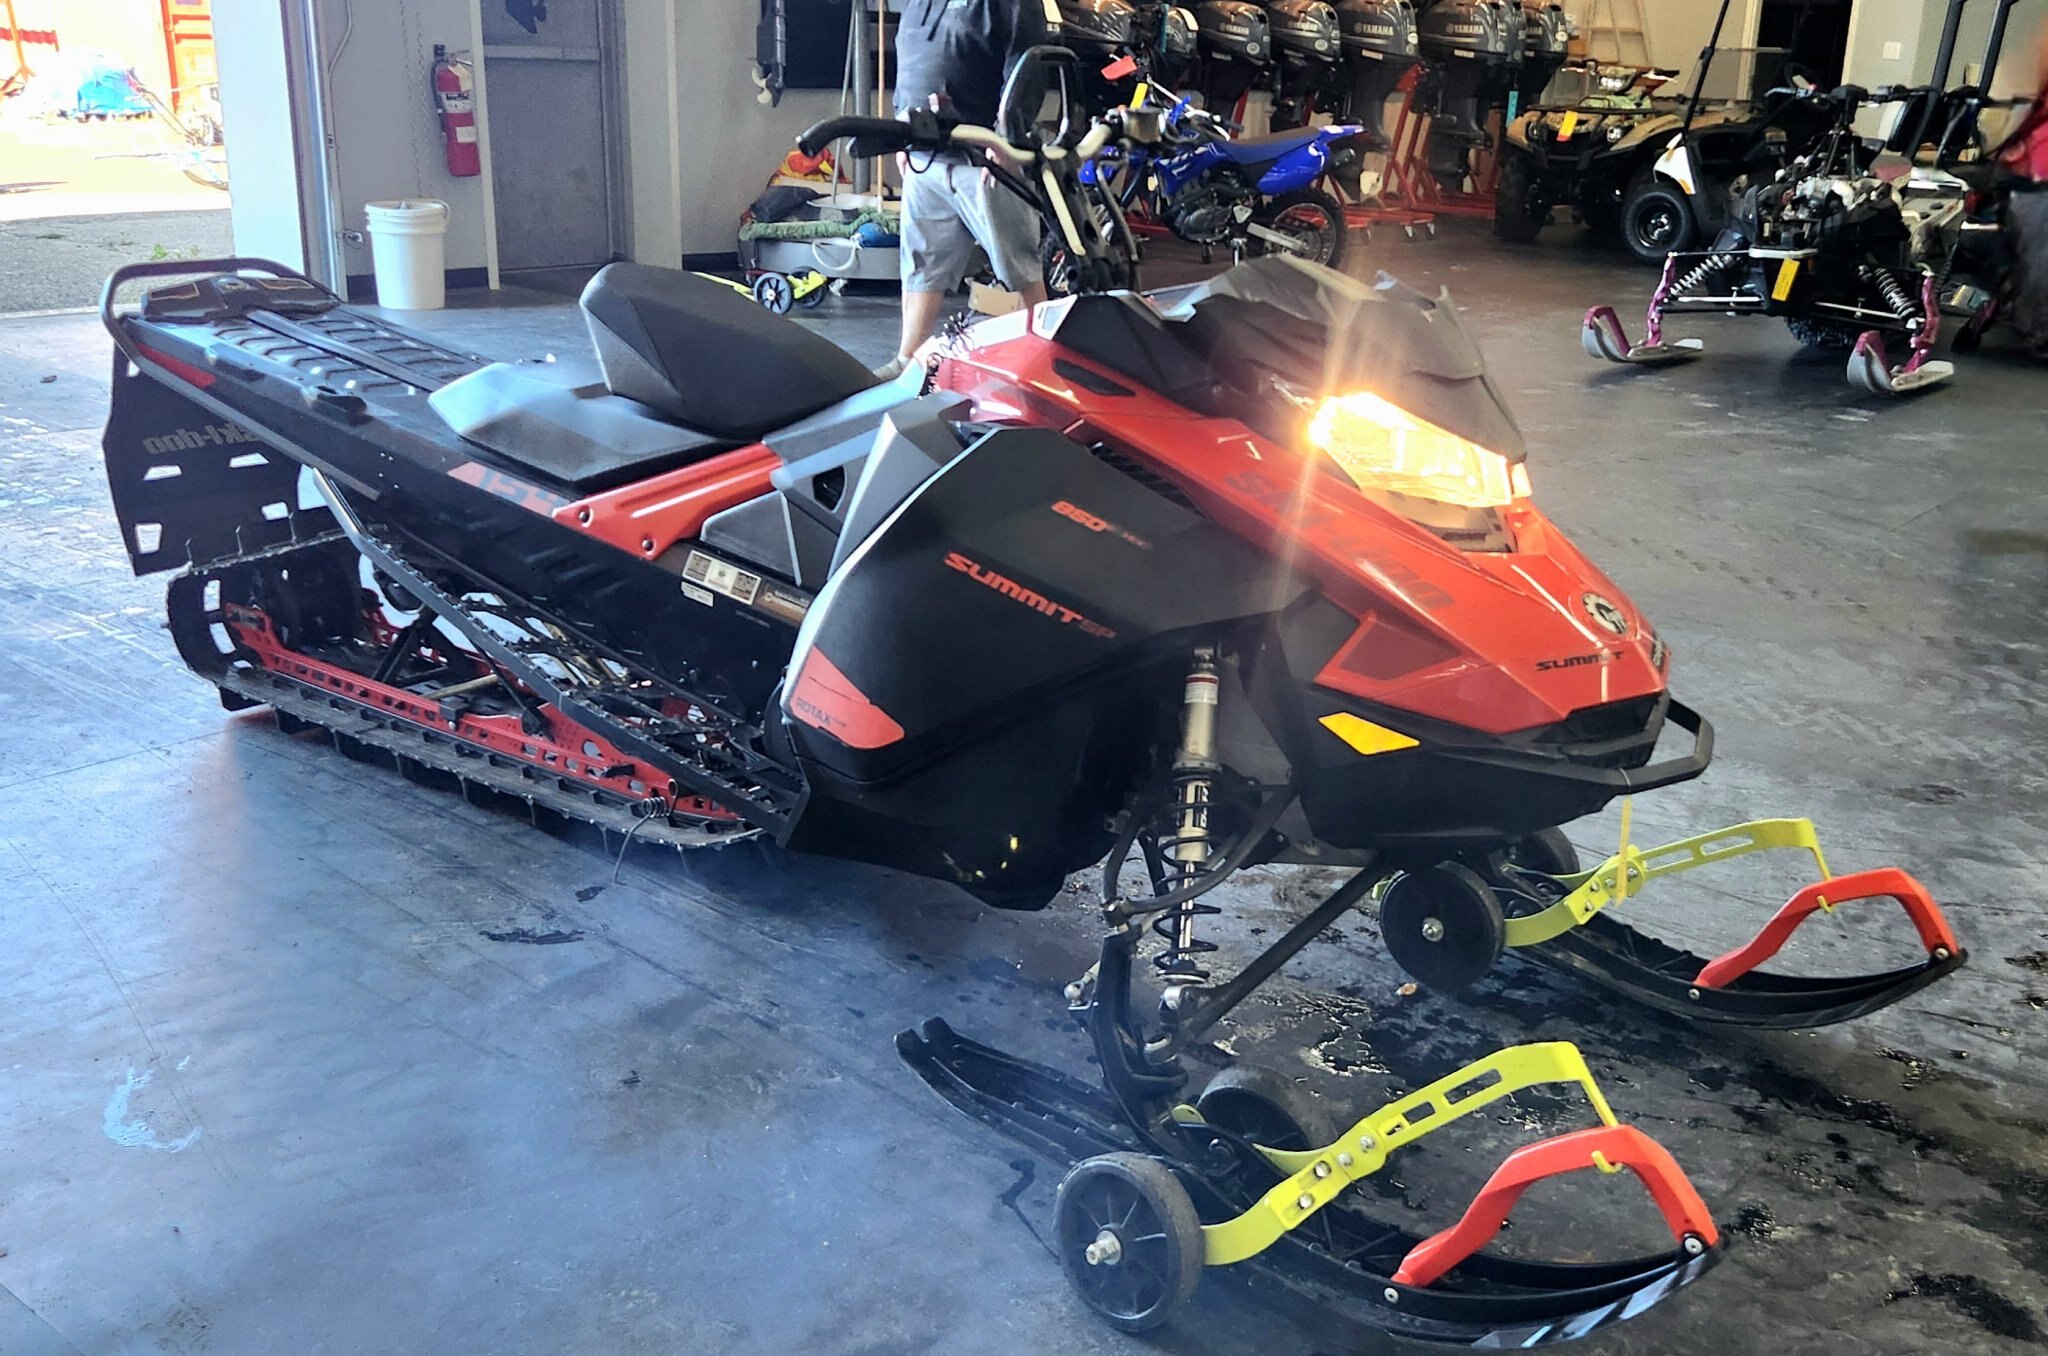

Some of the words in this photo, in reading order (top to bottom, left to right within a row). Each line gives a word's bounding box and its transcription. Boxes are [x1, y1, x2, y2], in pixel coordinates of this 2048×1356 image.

[1362, 24, 1394, 36] YAMAHA
[1454, 24, 1484, 35] YAMAHA
[1051, 500, 1107, 532] 850
[944, 551, 1083, 624] SUMMIT
[1078, 617, 1117, 639] SP
[1536, 650, 1624, 671] SUMMT
[796, 697, 831, 726] ROTAX
